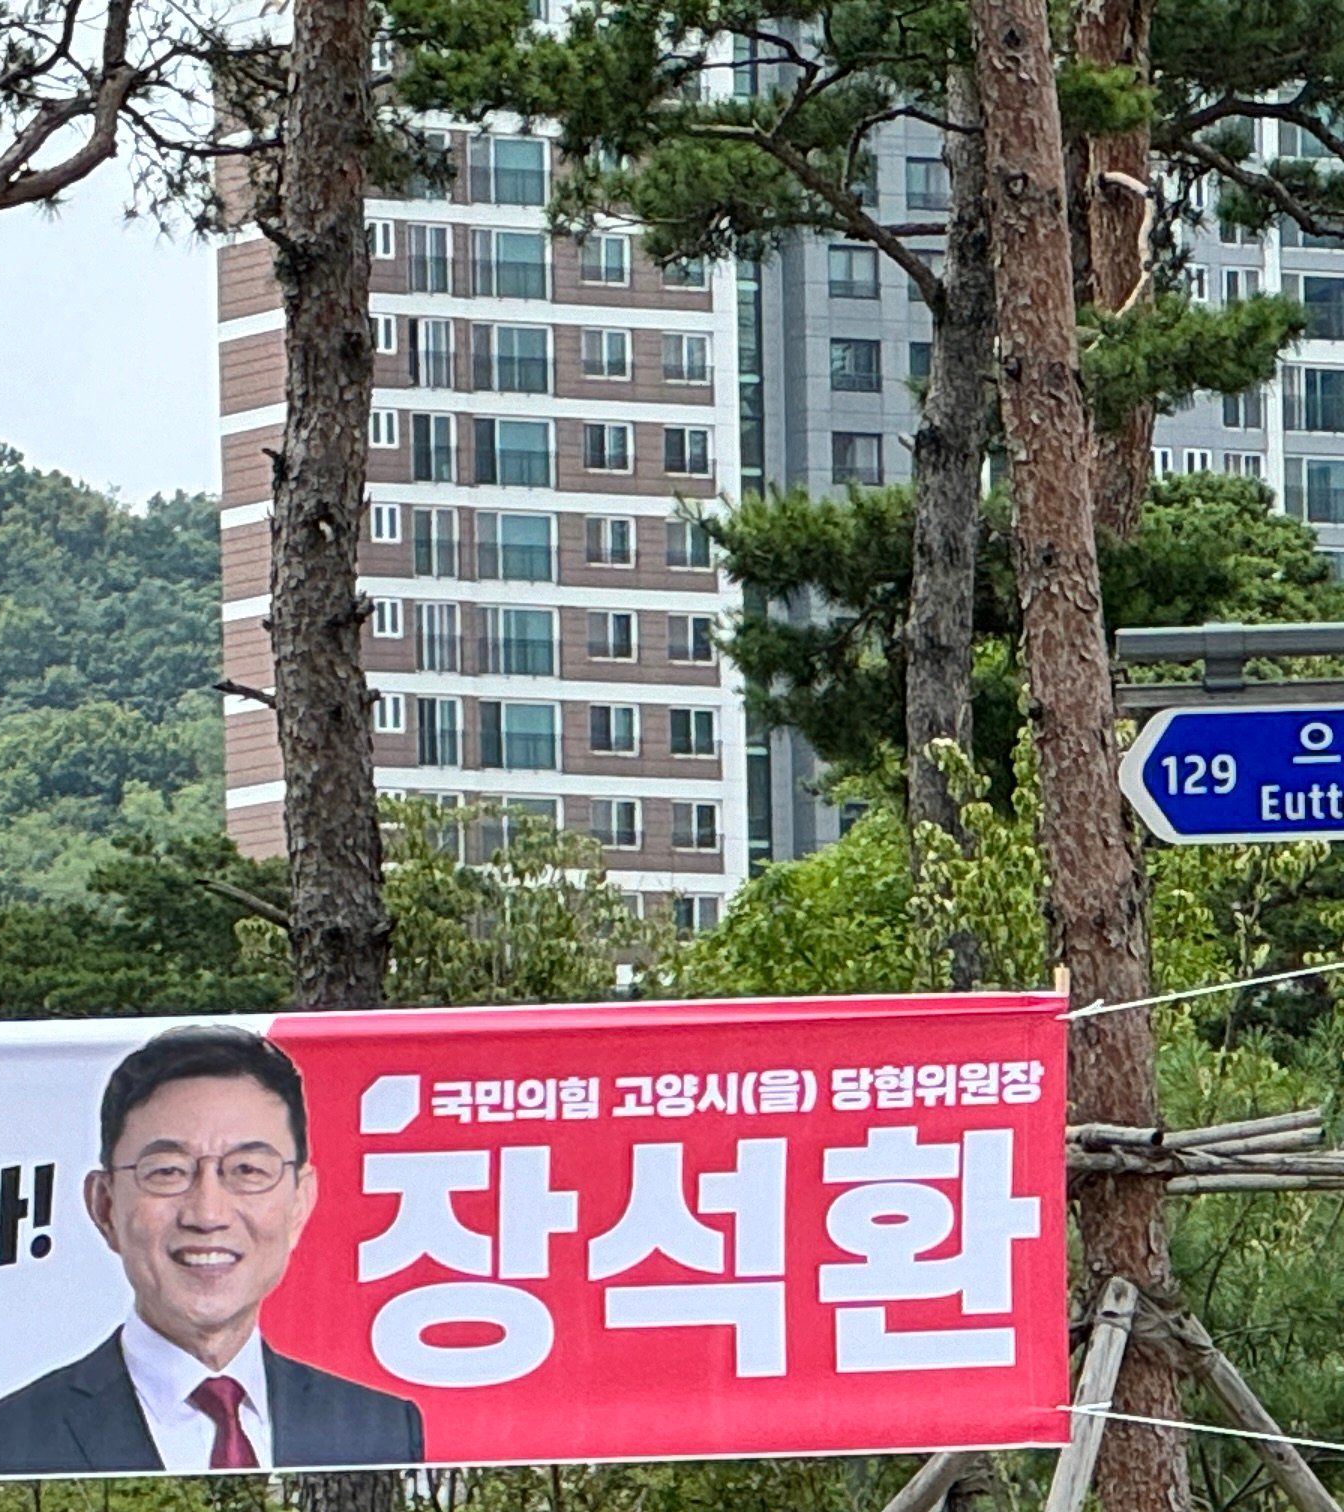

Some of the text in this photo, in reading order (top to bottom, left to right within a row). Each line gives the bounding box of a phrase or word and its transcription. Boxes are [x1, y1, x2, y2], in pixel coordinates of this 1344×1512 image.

[1162, 754, 1237, 795] 129
[431, 1060, 1044, 1124] 국민의힘 고양시(을) 당협위원장
[357, 1126, 1042, 1388] 장석환
